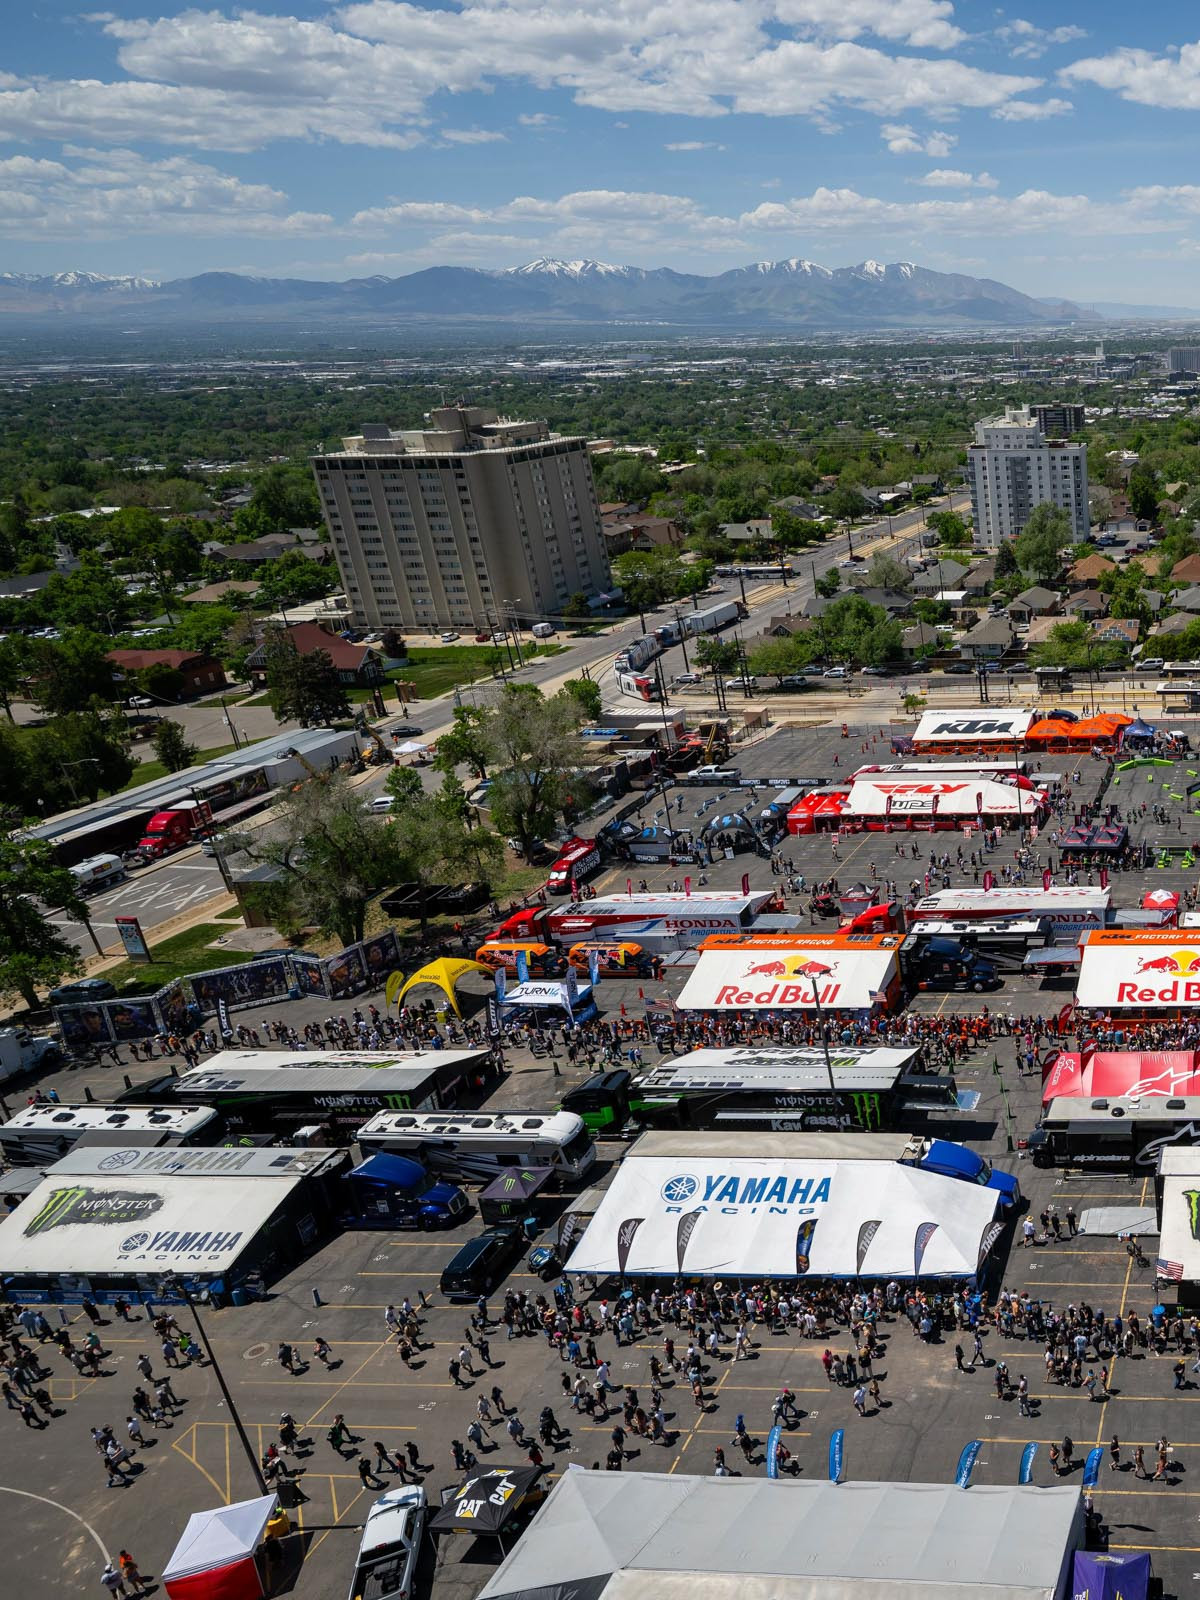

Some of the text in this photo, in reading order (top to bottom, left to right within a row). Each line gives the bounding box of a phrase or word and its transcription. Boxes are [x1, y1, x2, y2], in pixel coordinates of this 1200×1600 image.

[931, 720, 1014, 734] KTM
[665, 919, 737, 928] HONDA
[714, 984, 841, 1004] Red Bull
[1117, 980, 1179, 1002] Red
[313, 1096, 382, 1107] MONSTER
[774, 1096, 845, 1107] MONSTER
[131, 1151, 257, 1170] YAMAHA
[702, 1176, 832, 1204] YAMAHA
[78, 1199, 158, 1212] MONSTER
[665, 1206, 815, 1214] RACING
[146, 1231, 243, 1252] YAMAHA
[489, 1477, 517, 1506] CAT
[455, 1499, 487, 1518] CAT
